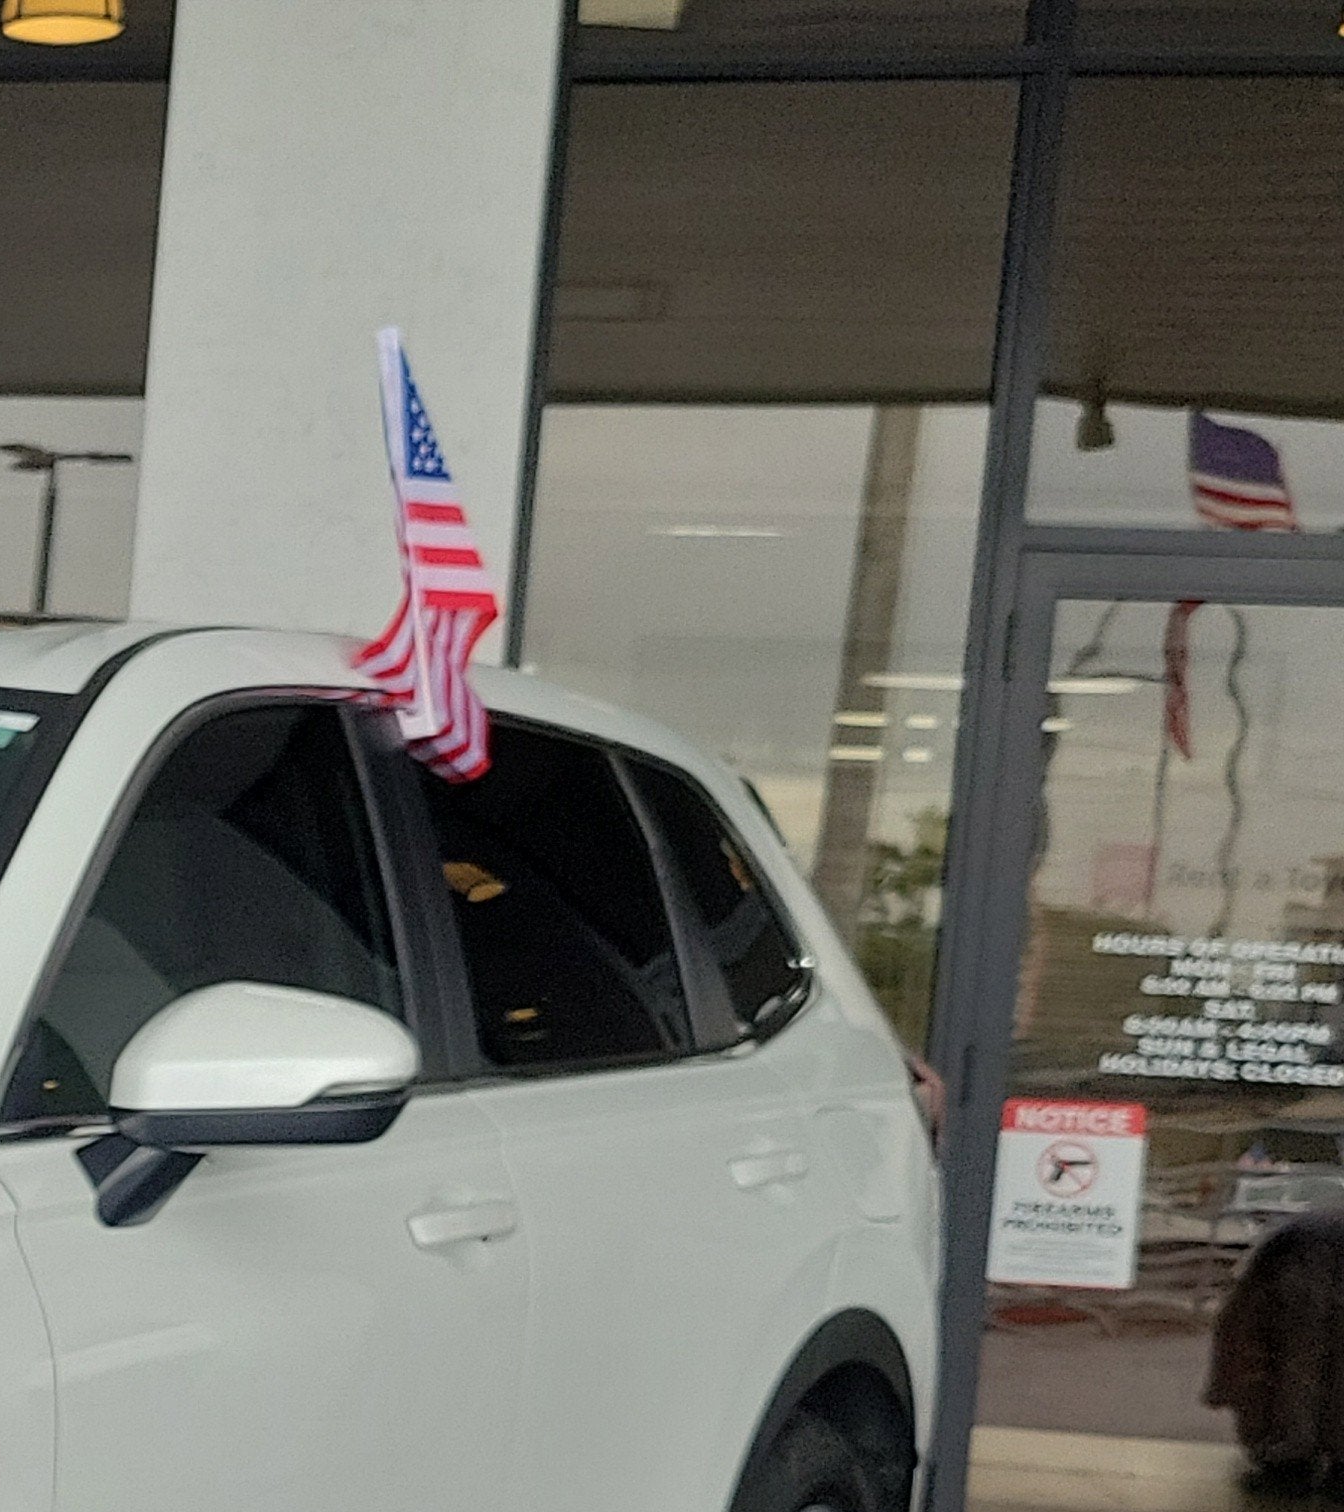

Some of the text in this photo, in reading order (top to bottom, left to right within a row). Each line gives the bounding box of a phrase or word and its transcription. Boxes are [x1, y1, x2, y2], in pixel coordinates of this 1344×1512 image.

[1092, 932, 1344, 964] HOURS OF OPERATI
[1138, 1036, 1194, 1057] SUN
[1225, 1040, 1311, 1065] LEGAL
[1240, 1062, 1344, 1087] CLOSED
[1015, 1105, 1132, 1135] NOTICE
